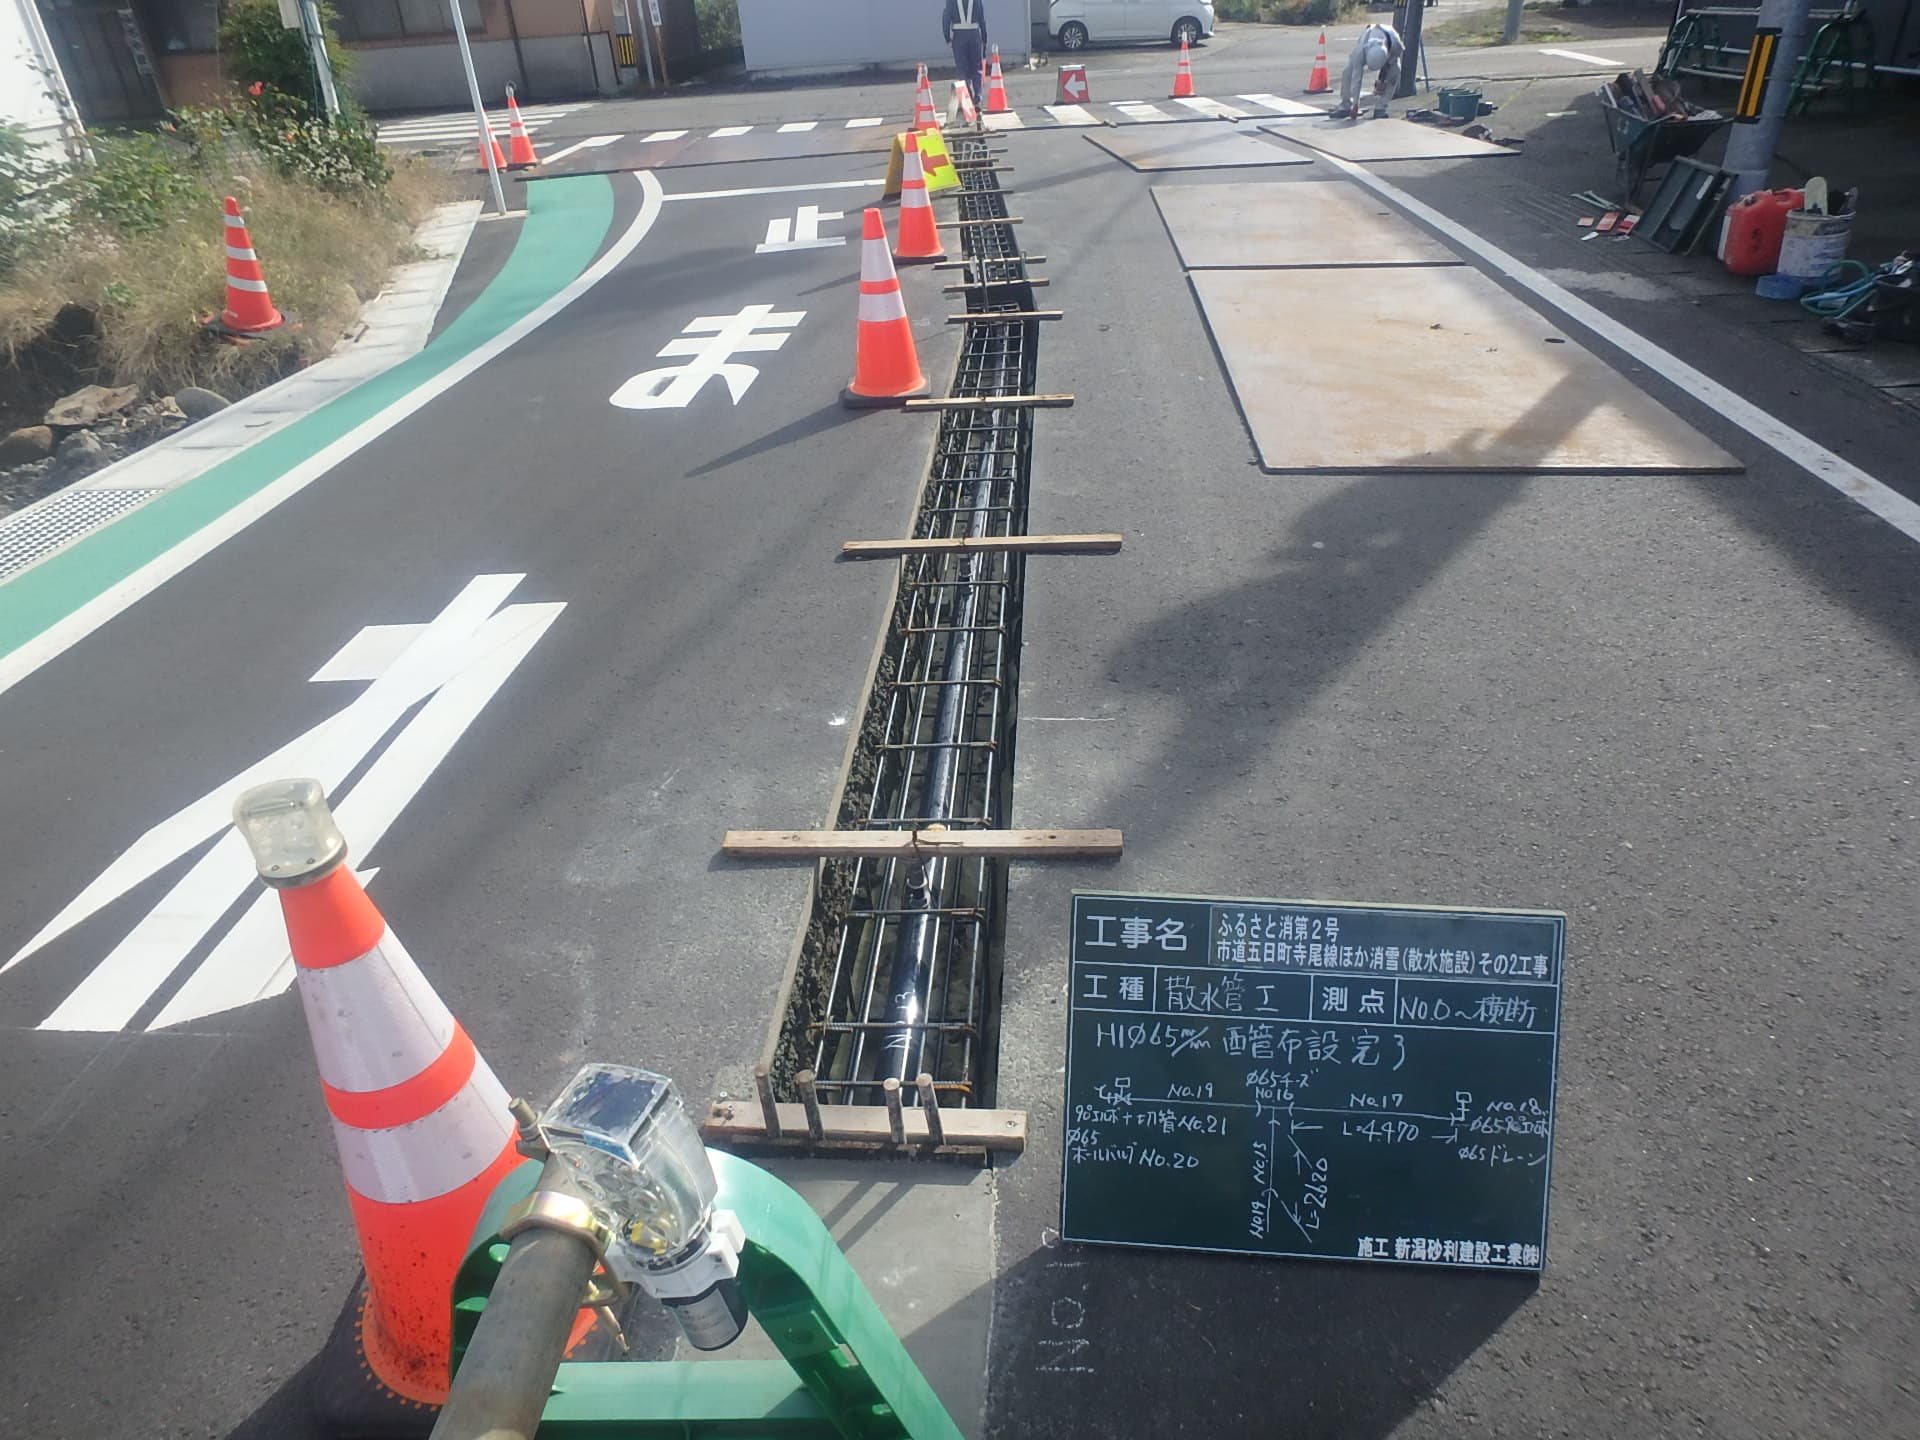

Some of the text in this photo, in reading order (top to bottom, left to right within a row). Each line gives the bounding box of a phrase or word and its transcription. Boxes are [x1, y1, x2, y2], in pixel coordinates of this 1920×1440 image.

[1084, 915, 1188, 951] 工事名
[1217, 912, 1340, 943] ふるさと消第2号
[1083, 974, 1145, 1001] 工種
[1322, 986, 1385, 1014] 測点
[1167, 1082, 1214, 1099] No.19
